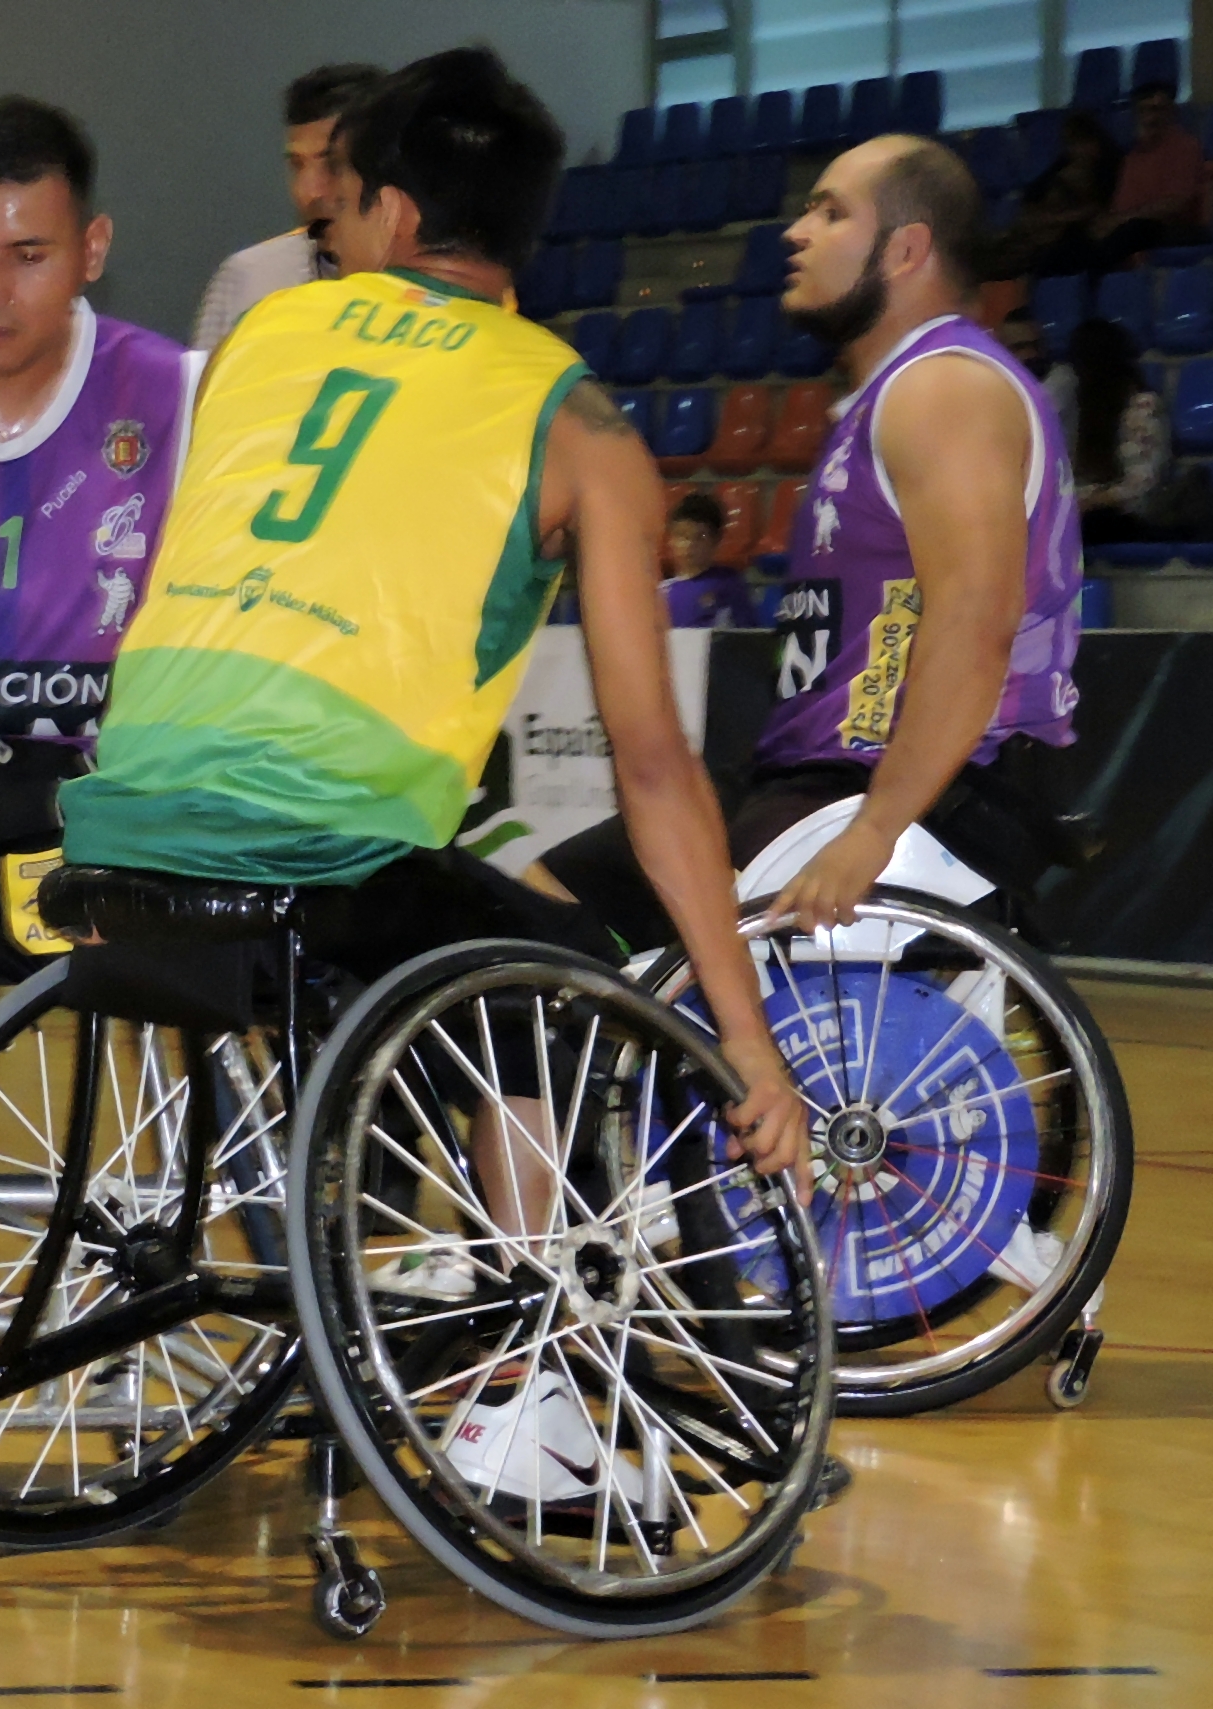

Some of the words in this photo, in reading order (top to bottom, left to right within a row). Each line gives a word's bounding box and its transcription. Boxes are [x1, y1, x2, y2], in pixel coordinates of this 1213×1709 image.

[331, 299, 479, 351] FLACO
[41, 468, 88, 519] Pucela
[250, 366, 402, 543] 9
[867, 1150, 988, 1281] MICHELIN
